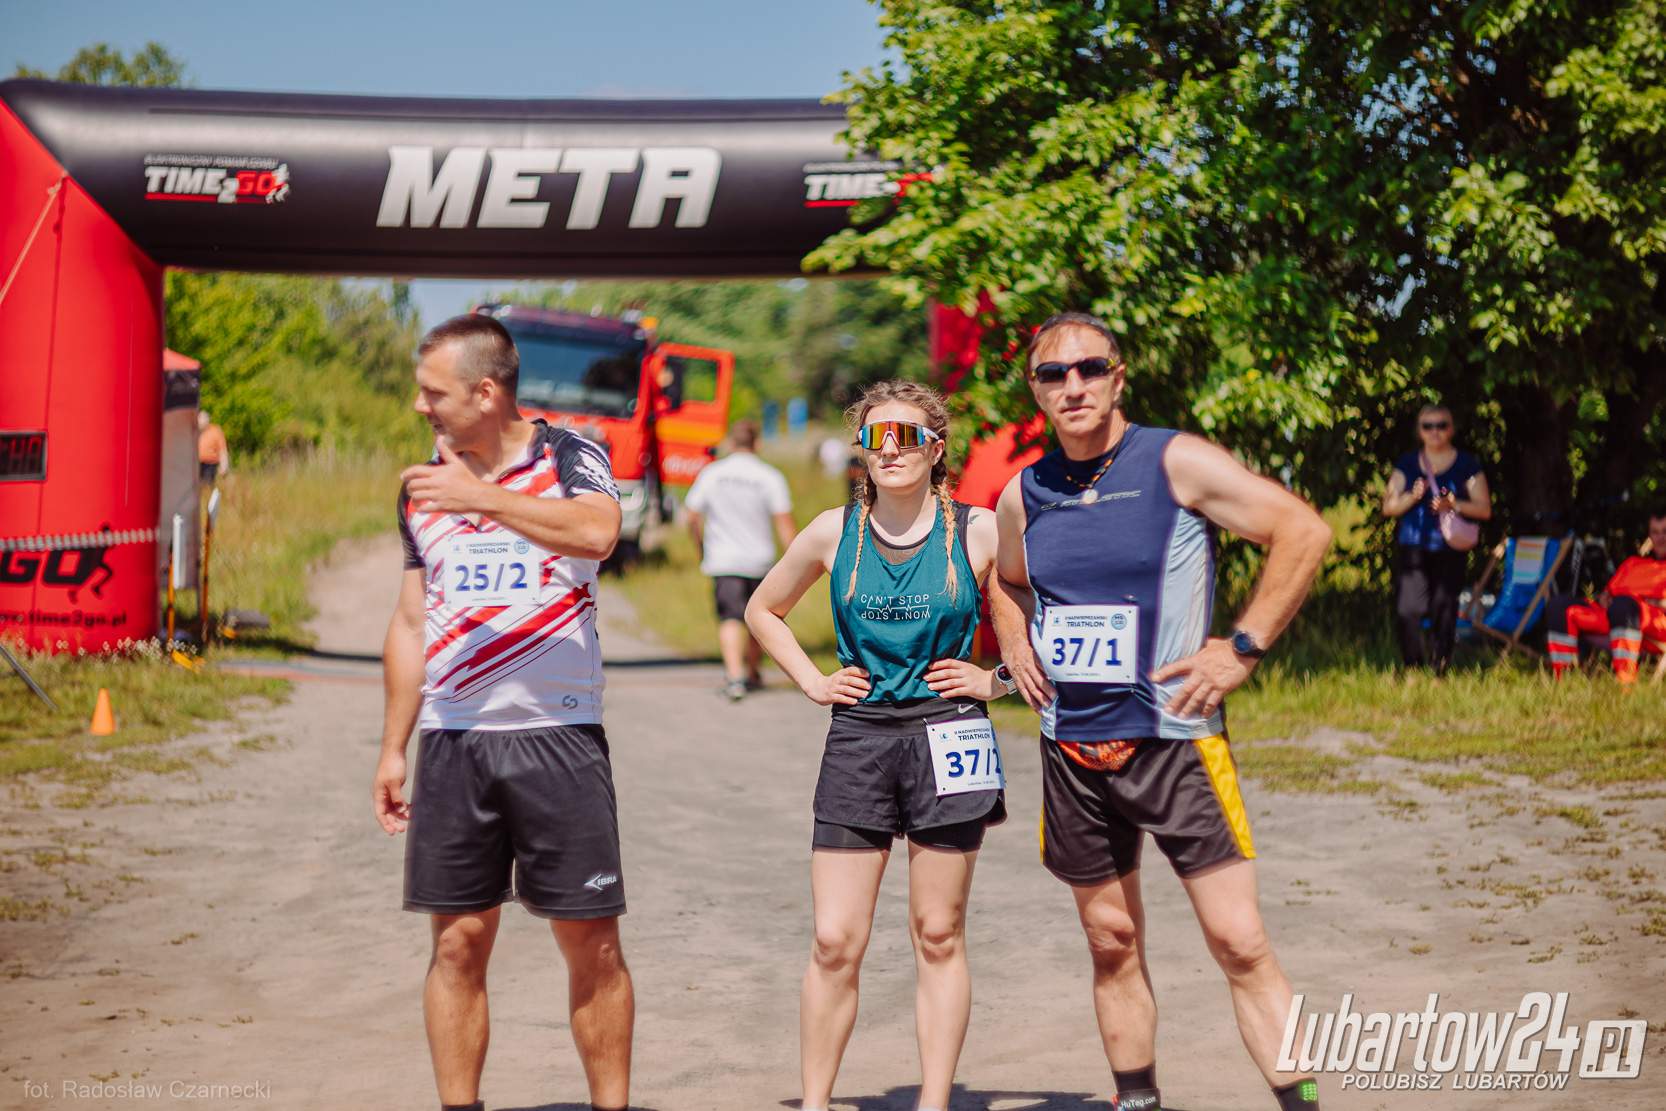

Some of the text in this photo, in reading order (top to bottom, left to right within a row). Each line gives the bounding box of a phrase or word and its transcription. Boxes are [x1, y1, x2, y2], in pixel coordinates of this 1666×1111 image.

[376, 145, 722, 230] META
[455, 562, 528, 592] 25/2
[860, 593, 930, 608] CAN'T STOP
[860, 610, 931, 621] WON'T STOP
[1051, 637, 1122, 668] 37/1
[958, 733, 991, 741] TRIATHLON
